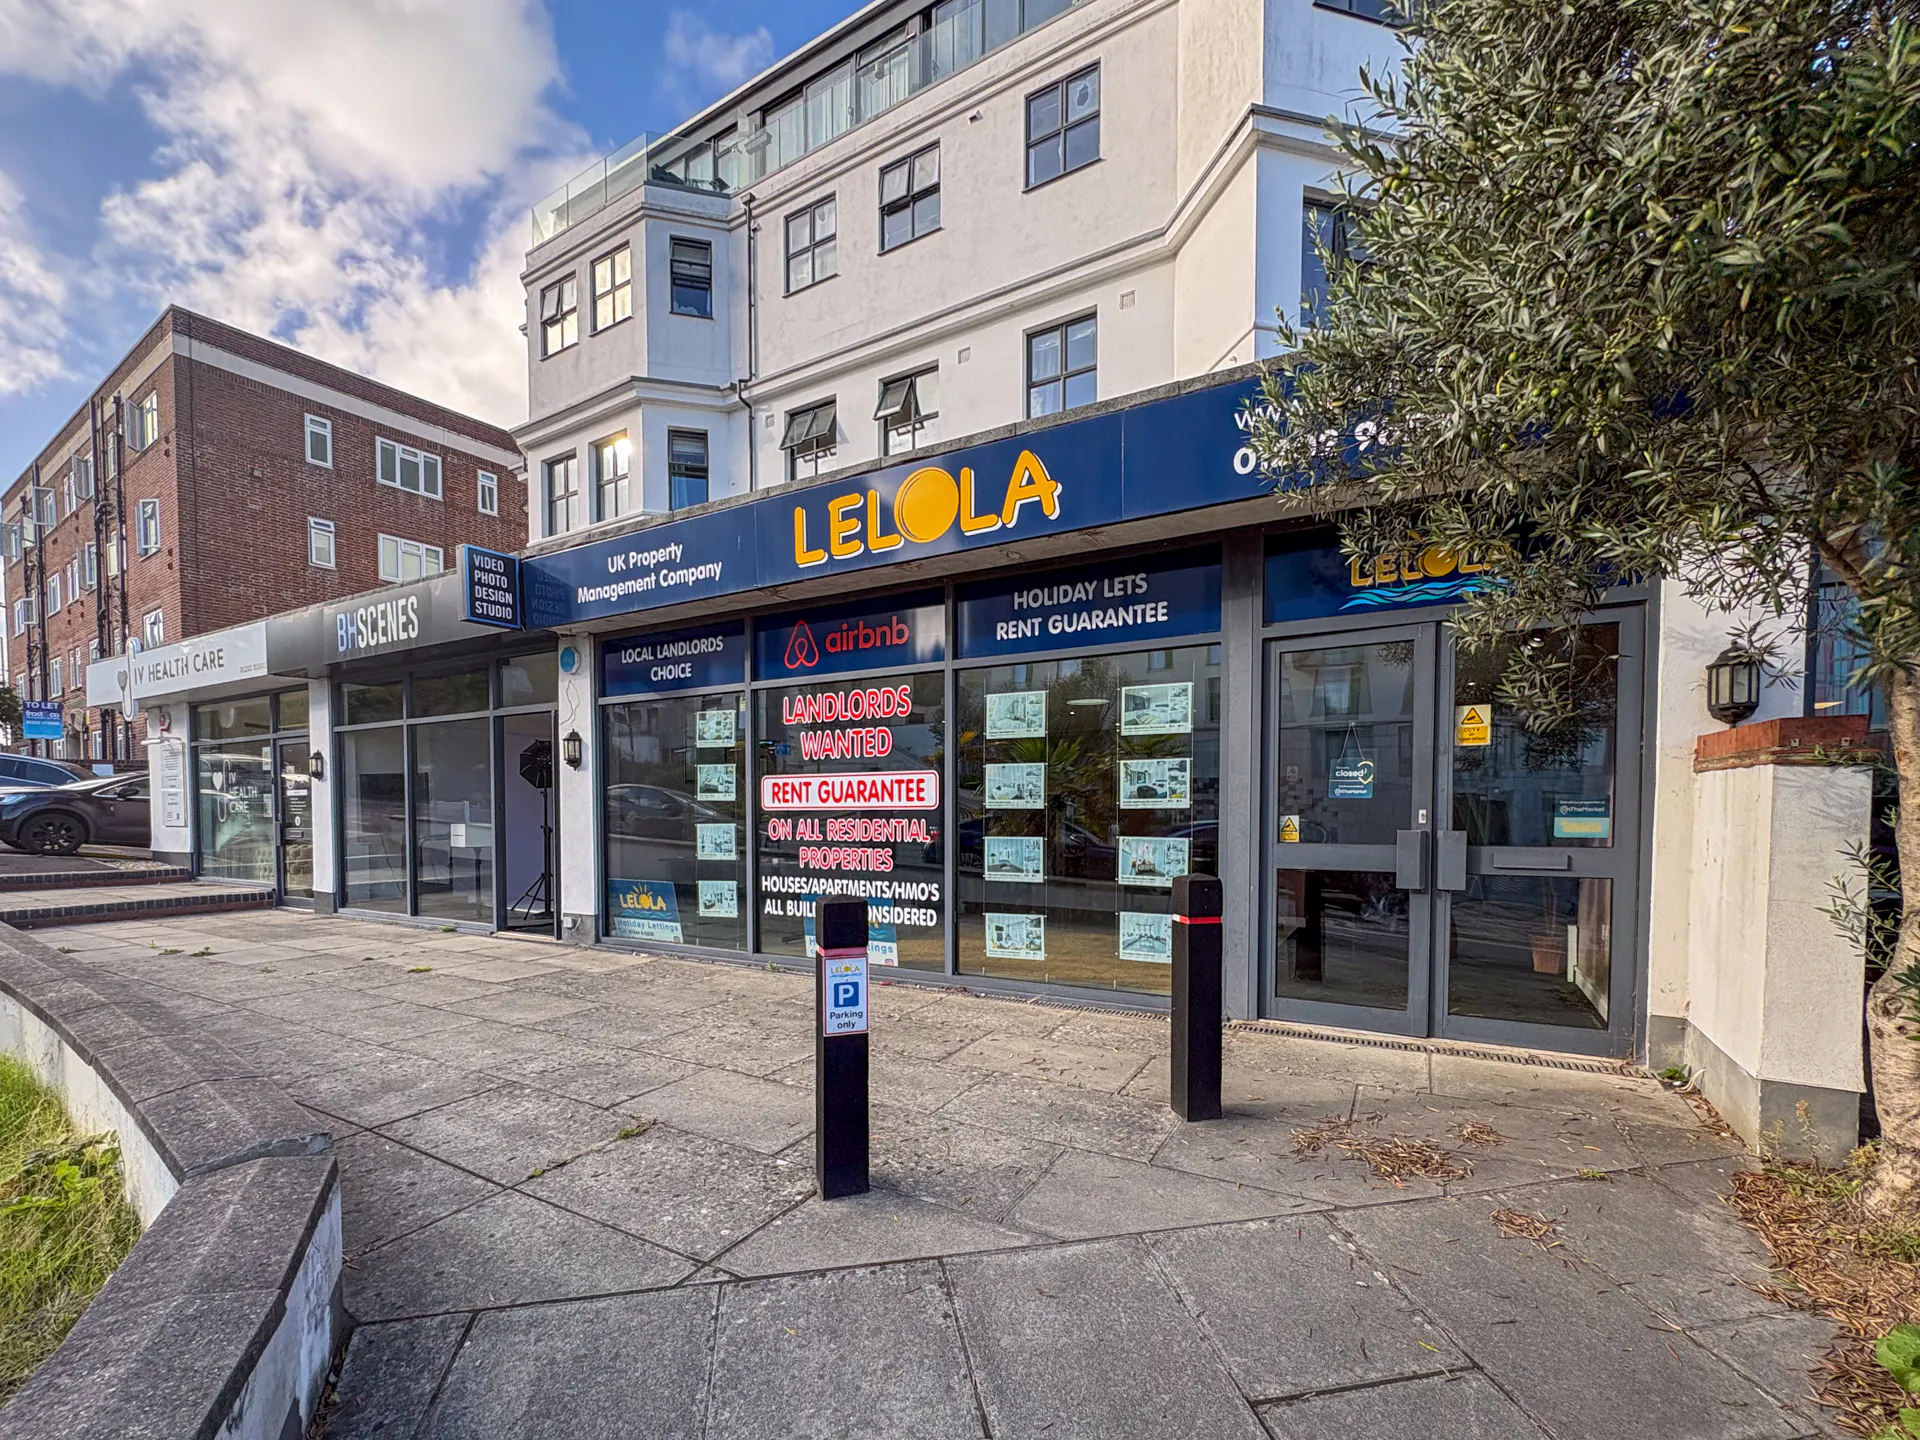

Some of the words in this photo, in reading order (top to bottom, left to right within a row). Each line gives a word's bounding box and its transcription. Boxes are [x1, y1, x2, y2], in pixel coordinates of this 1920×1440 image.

[794, 450, 1063, 569] LELOLA
[473, 553, 505, 573] VIDEO
[608, 554, 627, 574] UK
[629, 542, 683, 569] Property
[1351, 541, 1492, 587] LELOL
[474, 569, 508, 589] PHOTO
[577, 572, 656, 604] Management
[659, 562, 722, 586] Company
[474, 585, 513, 605] DESIGN
[1013, 580, 1097, 611] HOLIDAY
[1103, 573, 1148, 598] LETS
[475, 601, 513, 620] STUDIO
[996, 617, 1043, 641] RENT
[1048, 601, 1169, 635] GUARANTEE
[336, 595, 419, 652] BHSCENES
[825, 616, 910, 653] airbnb
[621, 646, 654, 664] LOCAL
[656, 636, 724, 659] LANDLORDS
[134, 666, 144, 685] IV
[148, 656, 189, 682] HEALTH
[193, 648, 224, 672] CARE
[650, 662, 692, 682] CHOICE
[25, 701, 39, 709] TO
[783, 685, 911, 725] LANDLORDS
[800, 727, 892, 760] WANTED
[1335, 769, 1364, 777] closed
[229, 786, 258, 798] HEALTH
[772, 781, 812, 804] RENT
[817, 778, 925, 803] GUARANTEE
[229, 802, 250, 814] CARE
[768, 818, 792, 841] ON
[796, 818, 823, 841] ALL
[827, 818, 930, 843] RESIDENTIAL
[799, 847, 894, 872] PROPERTIES
[761, 876, 940, 902] HOUSES/APARTMENTS/HMO'S
[620, 893, 666, 911] LELOLA
[764, 899, 784, 915] ALL
[617, 919, 645, 929] Holiday
[647, 921, 679, 932] Lettings
[838, 985, 854, 1005] P
[830, 1011, 863, 1019] Parking
[837, 1020, 856, 1029] only
